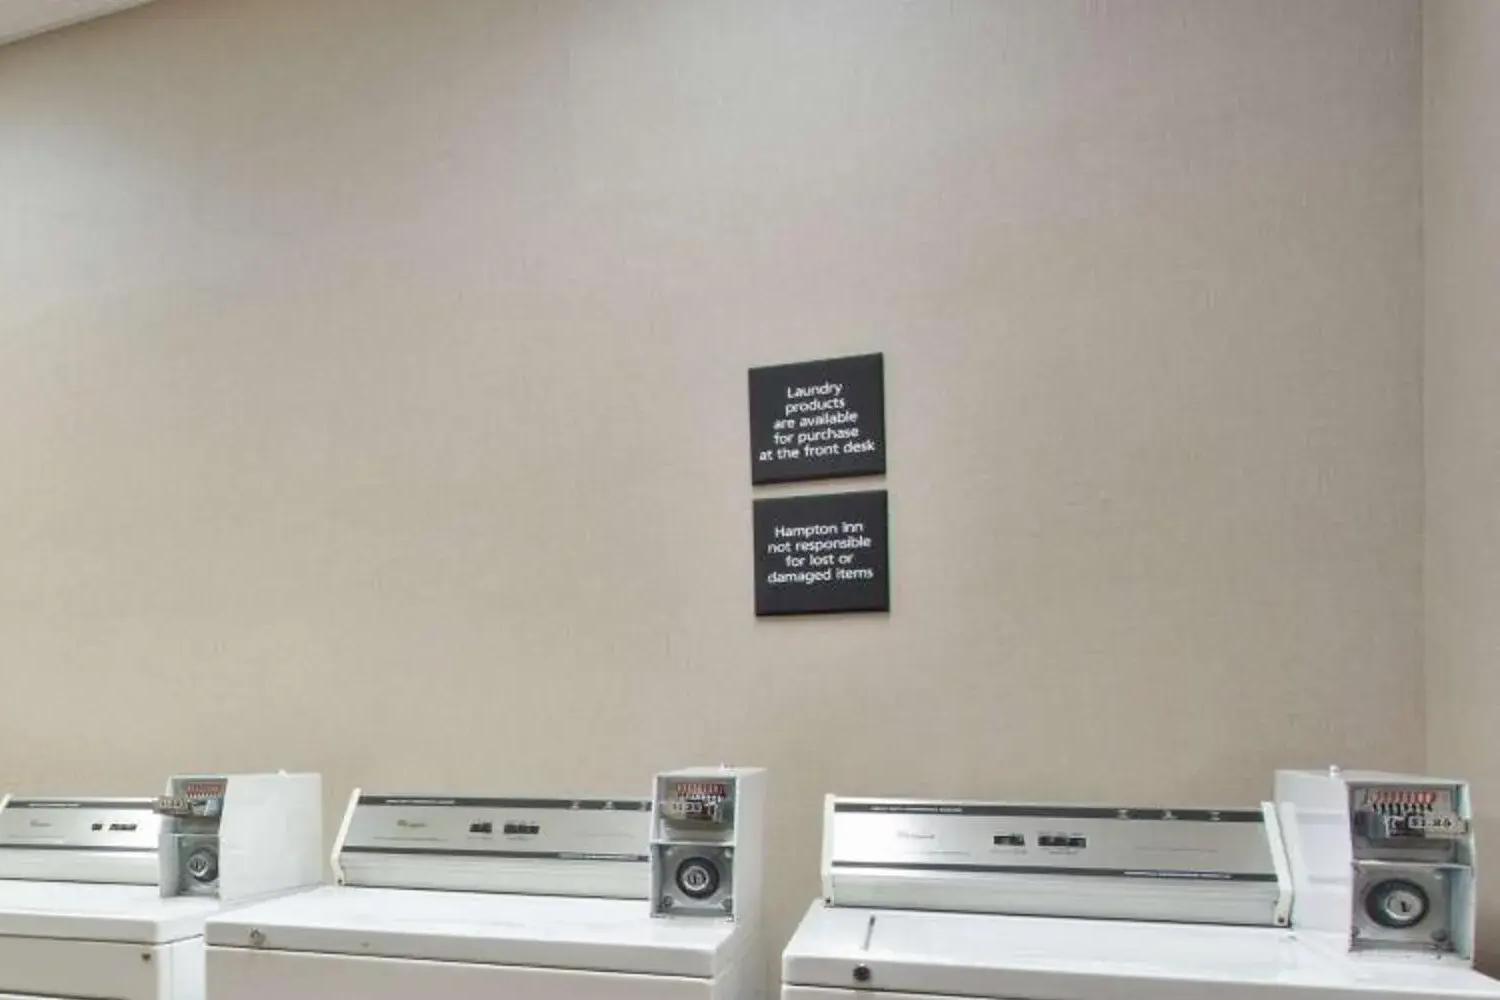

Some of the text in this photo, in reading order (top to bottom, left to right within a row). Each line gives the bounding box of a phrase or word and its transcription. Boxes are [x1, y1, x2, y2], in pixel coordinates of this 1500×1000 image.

[787, 382, 842, 398] Laundry
[785, 398, 845, 416] products
[773, 411, 859, 430] are available
[773, 427, 860, 445] for purchase
[759, 439, 876, 461] at the front desk
[774, 521, 864, 538] Hampton Inn
[767, 535, 872, 554] not responsible
[785, 553, 855, 568] for lost or
[767, 567, 874, 585] damaged items
